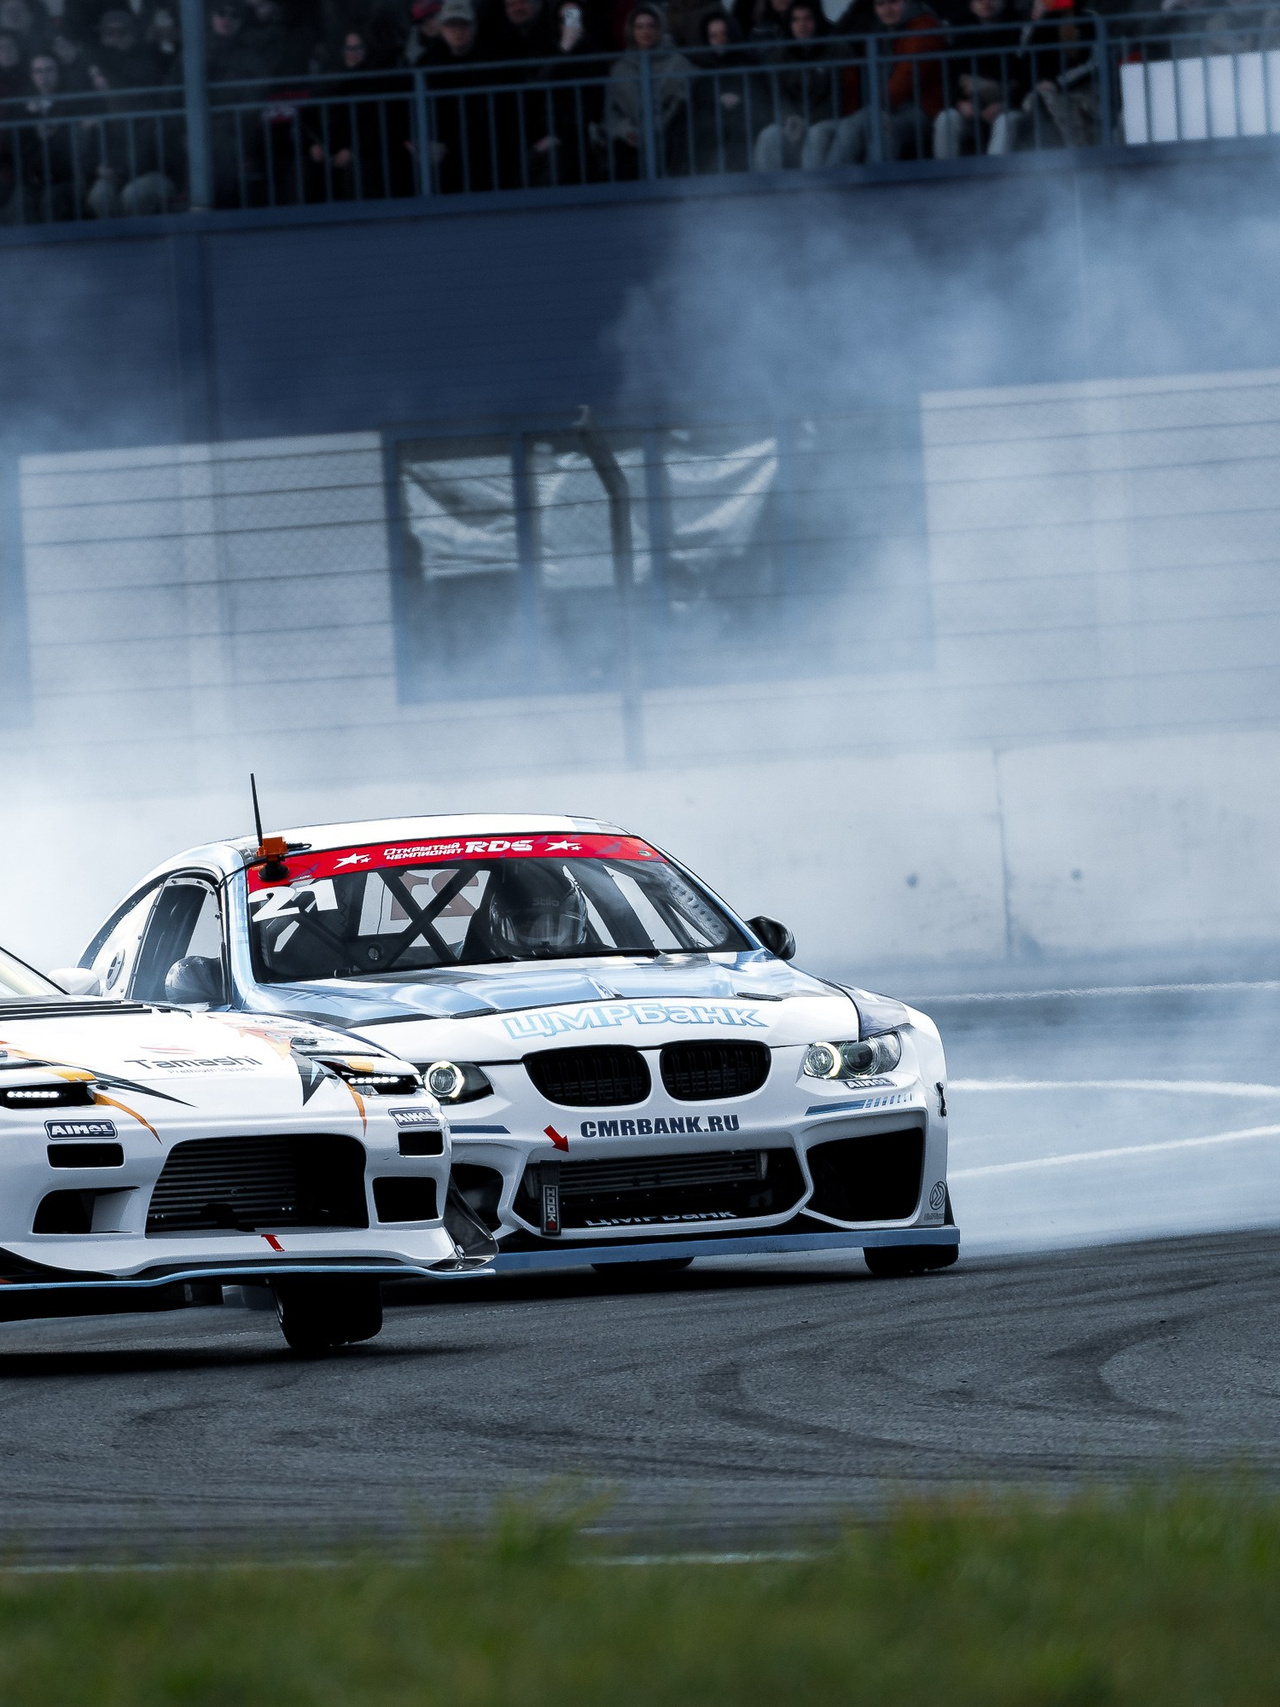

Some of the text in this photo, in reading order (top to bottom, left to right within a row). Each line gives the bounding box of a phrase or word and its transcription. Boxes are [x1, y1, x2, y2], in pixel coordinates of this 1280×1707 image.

[465, 840, 534, 853] RDS
[247, 878, 339, 922] 21
[501, 1003, 770, 1039] ЦМРБанк
[124, 1055, 263, 1070] Tamashi
[51, 1124, 114, 1136] AIMOL
[580, 1115, 740, 1138] CMRBANK.RU
